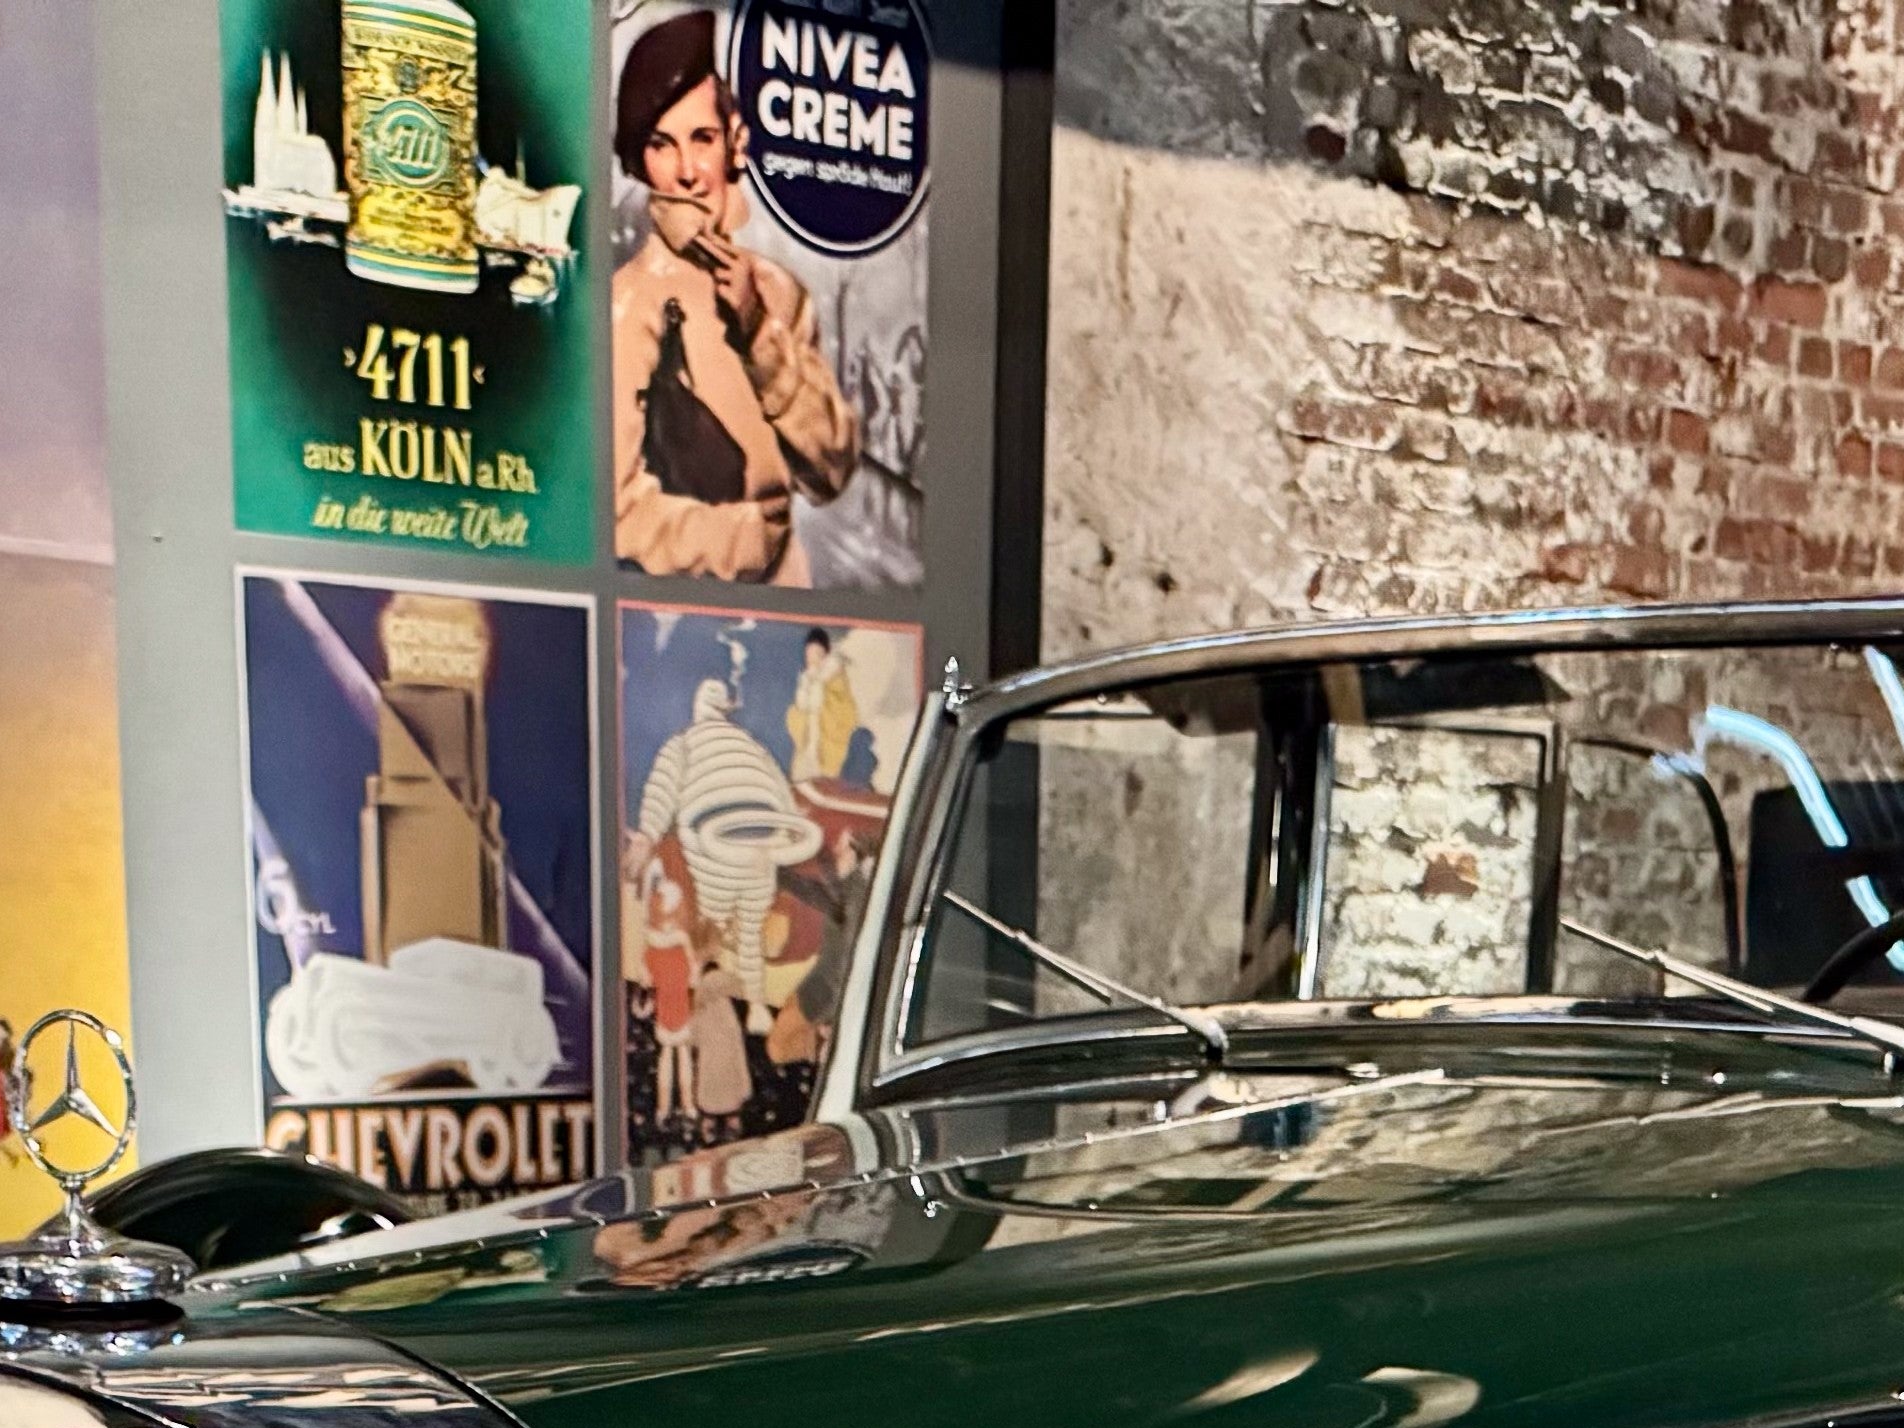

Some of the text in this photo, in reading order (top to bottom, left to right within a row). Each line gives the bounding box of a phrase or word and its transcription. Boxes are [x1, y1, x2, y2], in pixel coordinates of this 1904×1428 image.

[762, 10, 916, 98] NIVEA
[757, 79, 914, 160] CREME
[303, 442, 356, 473] aus
[358, 416, 473, 486] KÖLN
[266, 1103, 593, 1192] CHEVROLET
